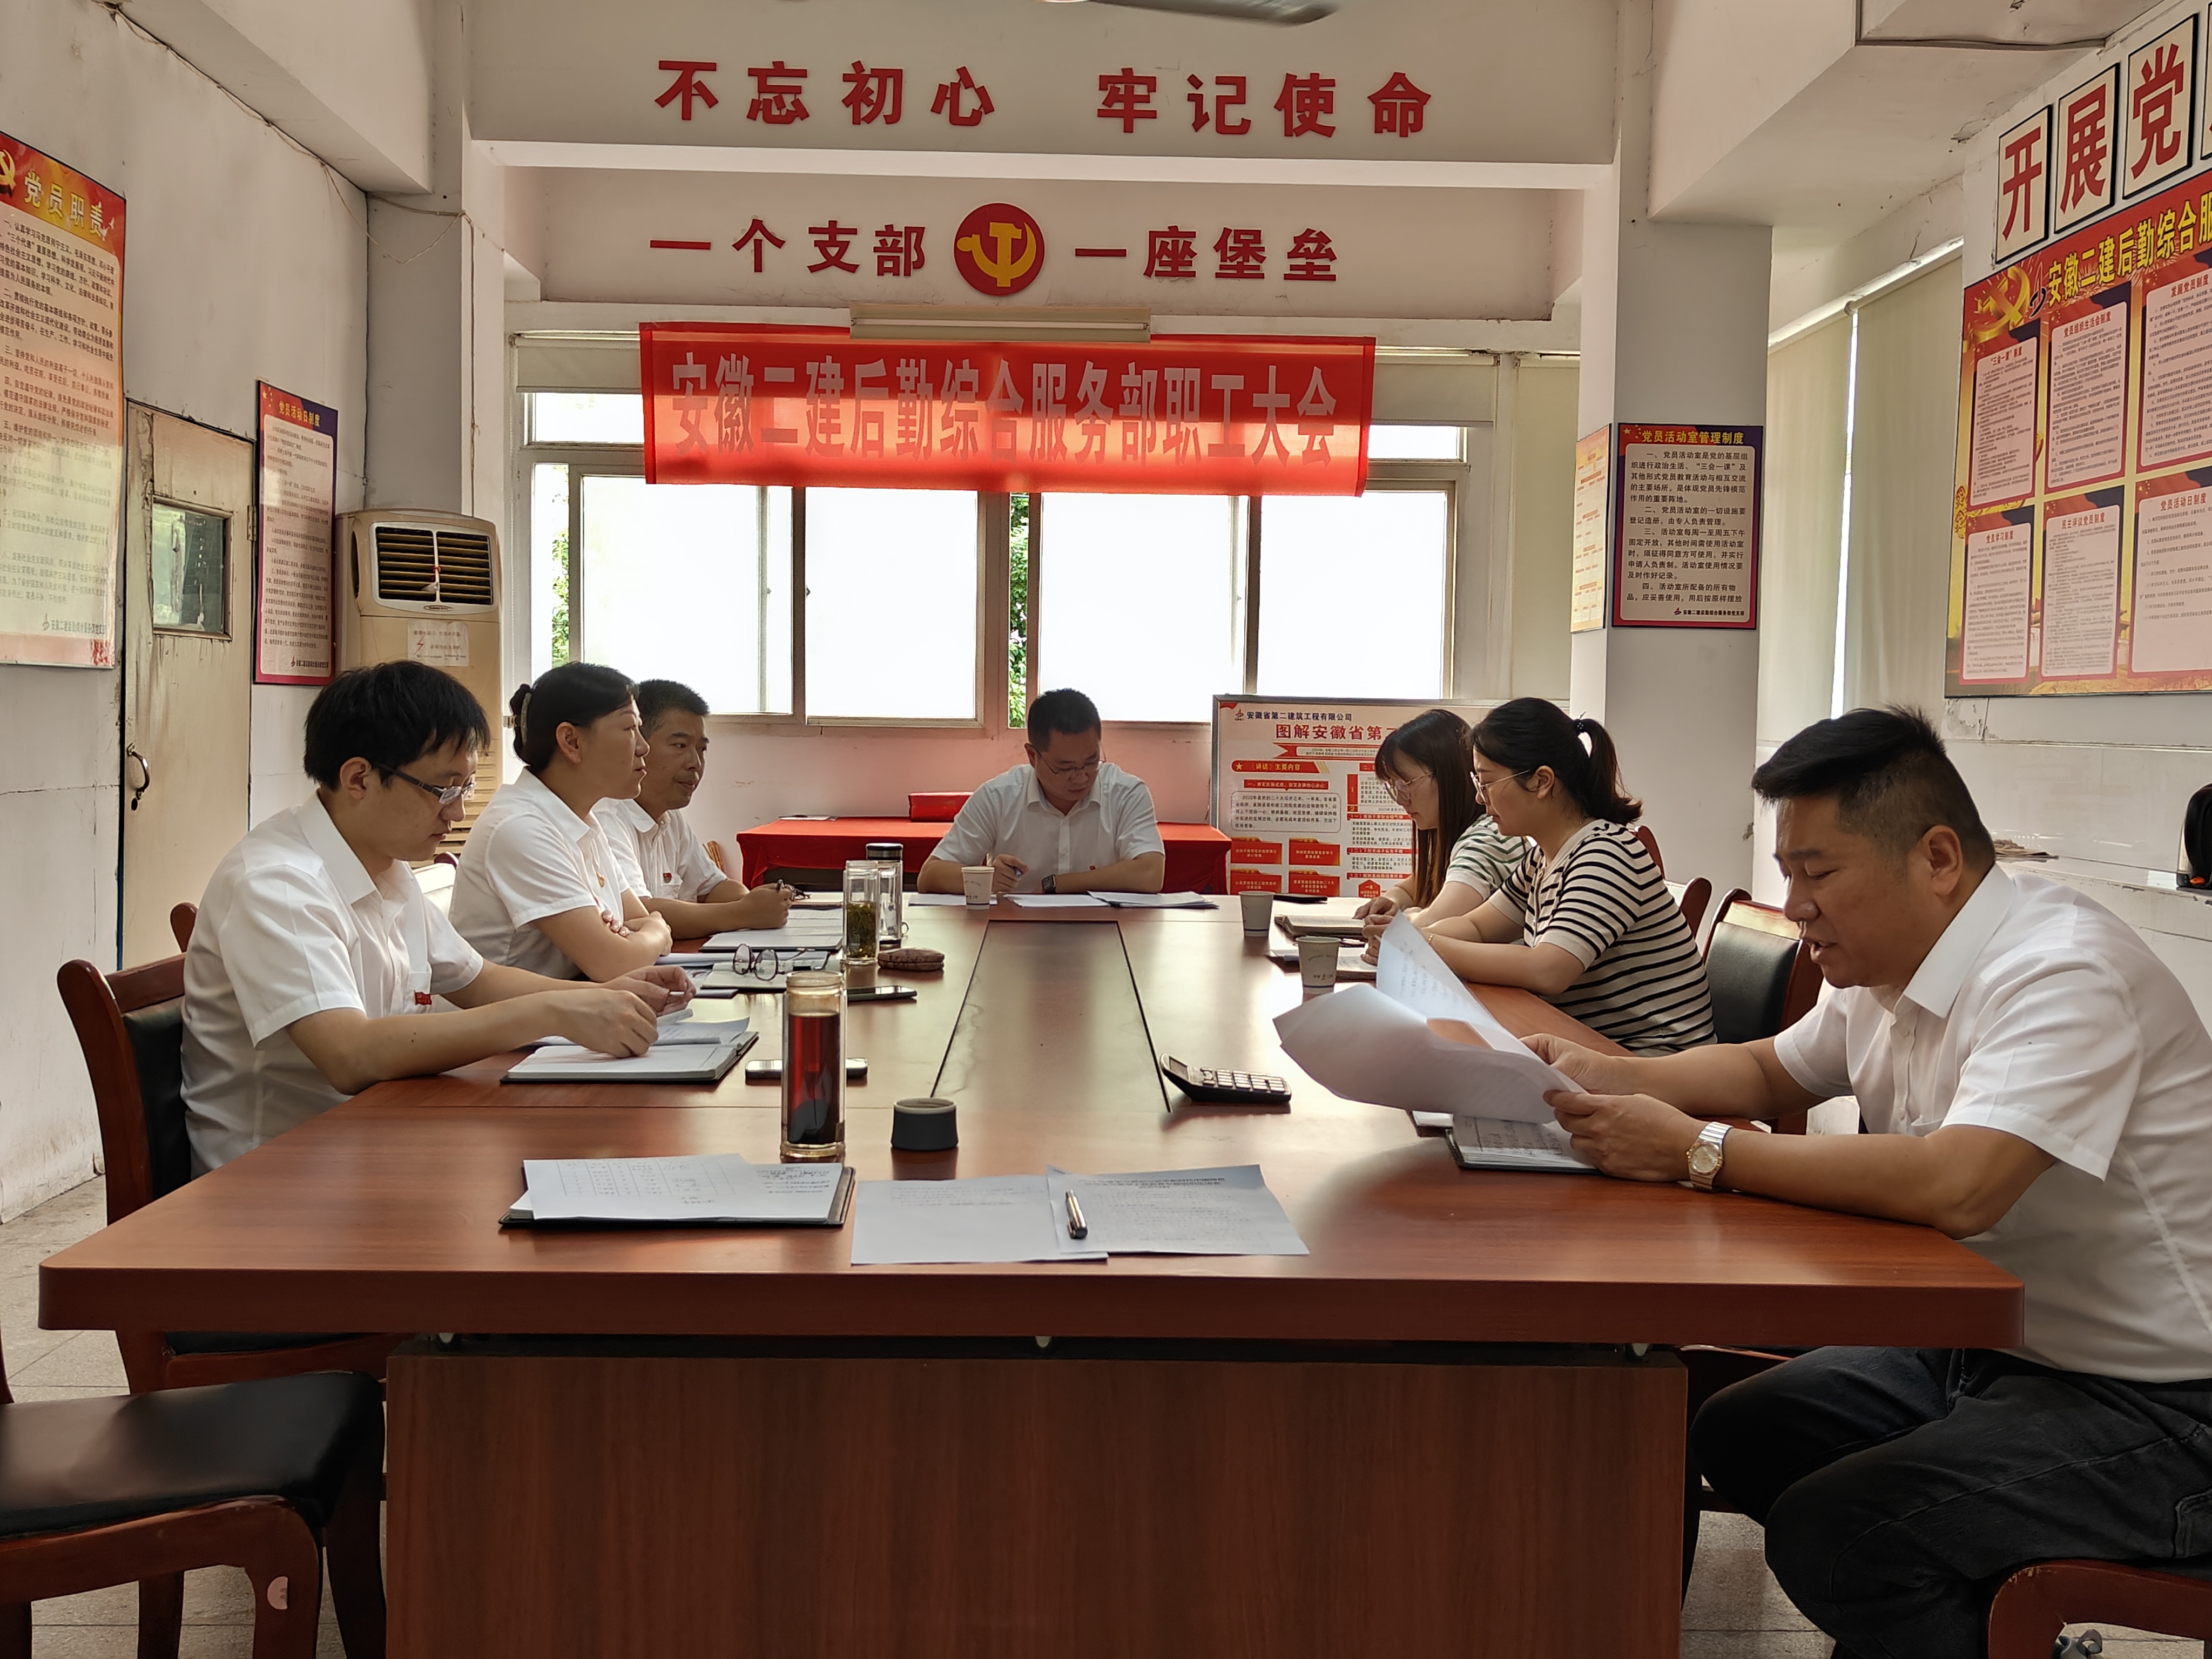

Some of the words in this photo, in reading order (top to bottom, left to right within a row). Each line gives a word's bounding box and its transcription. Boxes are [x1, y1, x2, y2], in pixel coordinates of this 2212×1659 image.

[655, 60, 994, 126] 不忘初心
[1098, 68, 1432, 138] 牢记使命
[2002, 43, 2212, 241] 开展党
[24, 171, 103, 238] 党员职责
[650, 219, 925, 276] 一个支部
[1075, 226, 1337, 281] 一座堡垒
[672, 352, 1336, 467] 安徽二建后勤综合服务部职工大会
[1642, 430, 1744, 444] 党员活动室管理制度
[1630, 494, 1688, 503] 作用的重要阵地。
[1631, 473, 1746, 482] 其他形式党员教育活动与相互交流
[1247, 711, 1352, 721] 安徽省第二建筑工程有限公司
